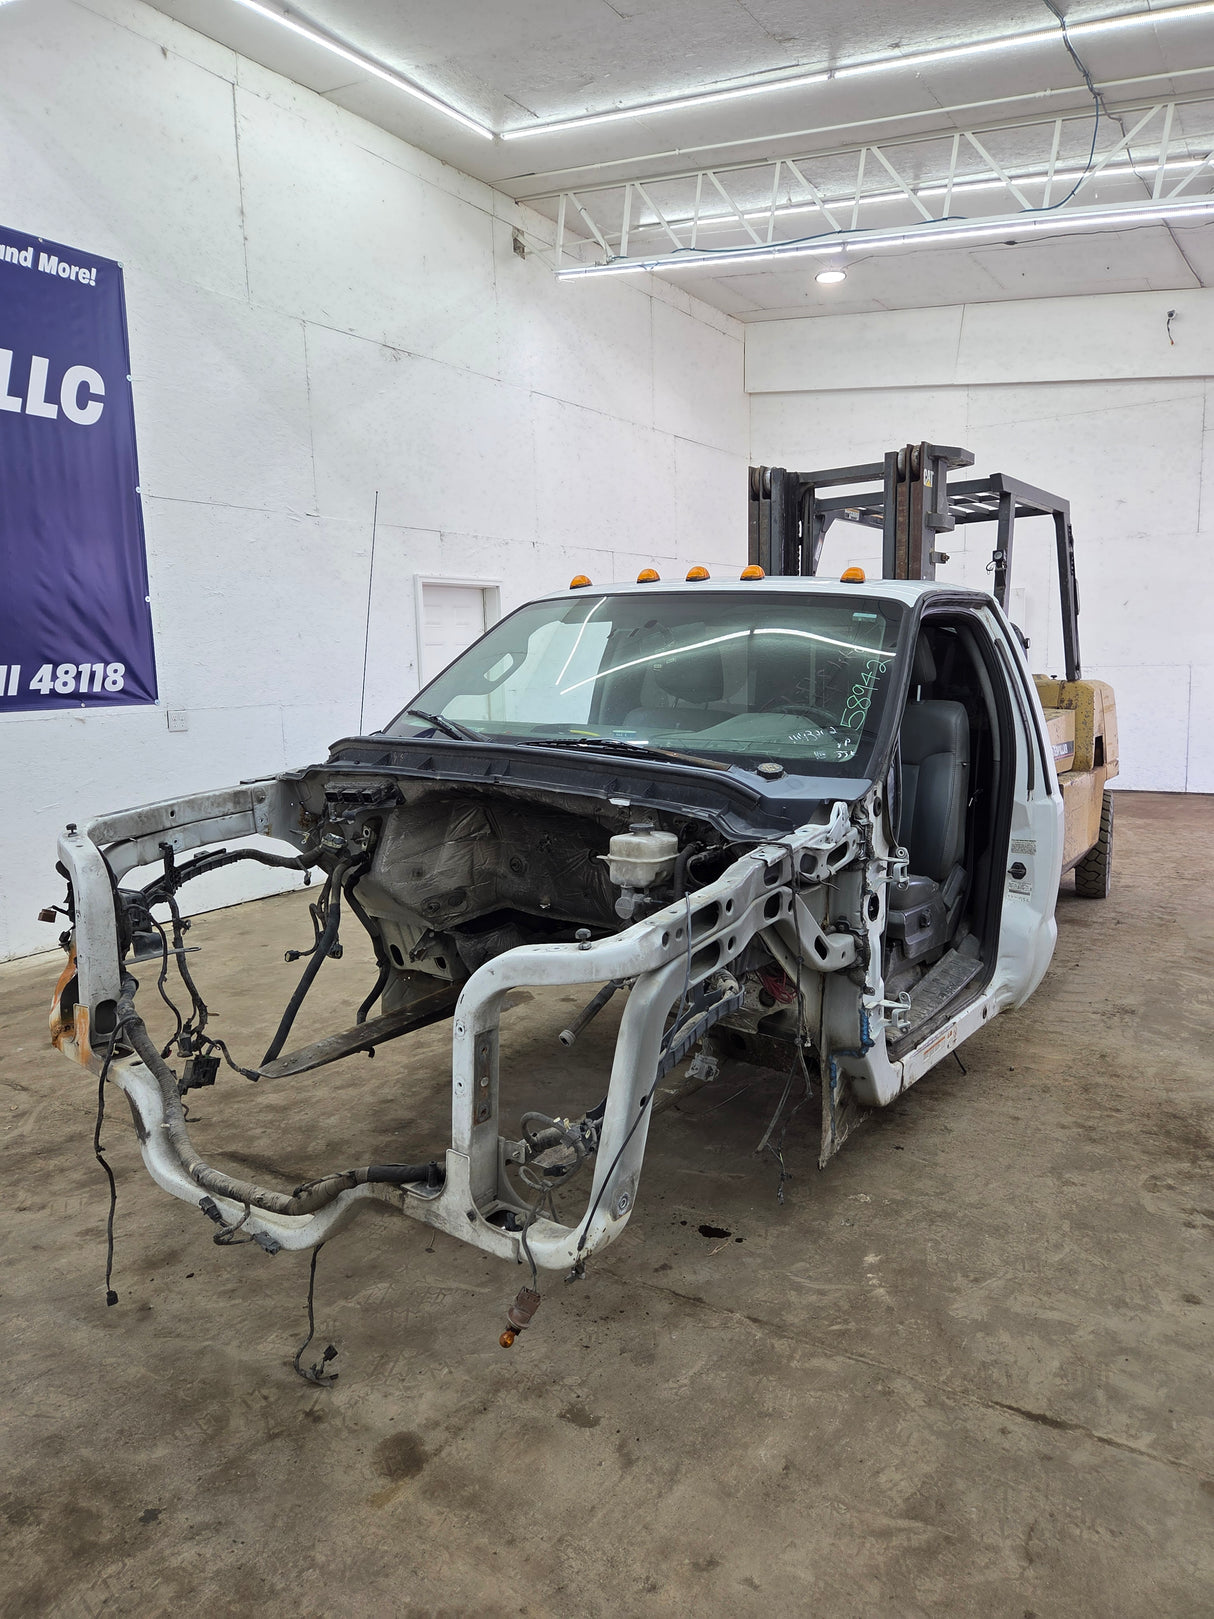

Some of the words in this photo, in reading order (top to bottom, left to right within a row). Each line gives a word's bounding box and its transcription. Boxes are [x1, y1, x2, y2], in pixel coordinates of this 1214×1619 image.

[38, 252, 97, 286] More!
[0, 347, 105, 425] LLC
[923, 468, 935, 488] CAT
[29, 662, 125, 694] 48118
[840, 659, 893, 731] 58942
